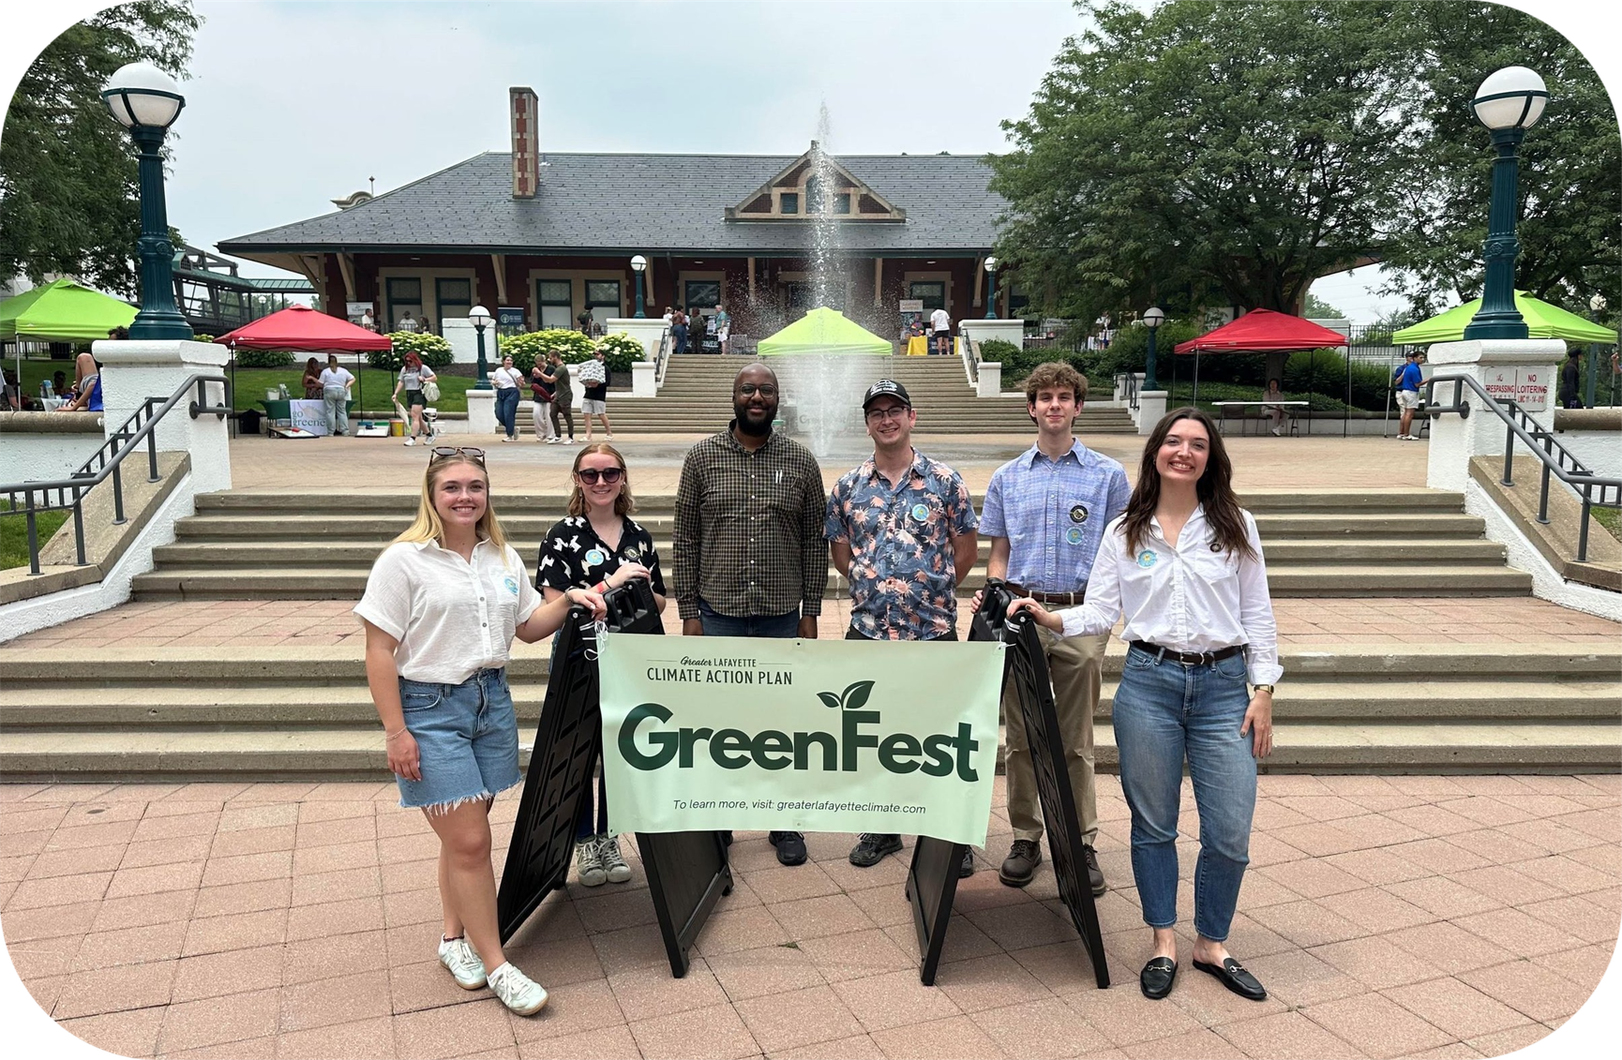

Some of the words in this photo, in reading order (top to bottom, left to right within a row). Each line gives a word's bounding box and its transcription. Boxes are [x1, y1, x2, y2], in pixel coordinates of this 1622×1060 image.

[1486, 385, 1514, 393] TRESPASSING
[292, 411, 304, 419] go
[293, 418, 326, 427] greene
[680, 655, 712, 668] Greater
[713, 658, 757, 667] LAFAYETTE
[647, 667, 701, 682] CLIMATE
[706, 669, 753, 684] ACTION
[758, 671, 793, 685] PLAN
[617, 702, 979, 783] GreenFest
[673, 799, 687, 810] To
[689, 799, 716, 809] learn
[718, 801, 749, 811] more,
[752, 799, 775, 810] visit:
[776, 800, 926, 814] greaterlafayetteclimate.com
